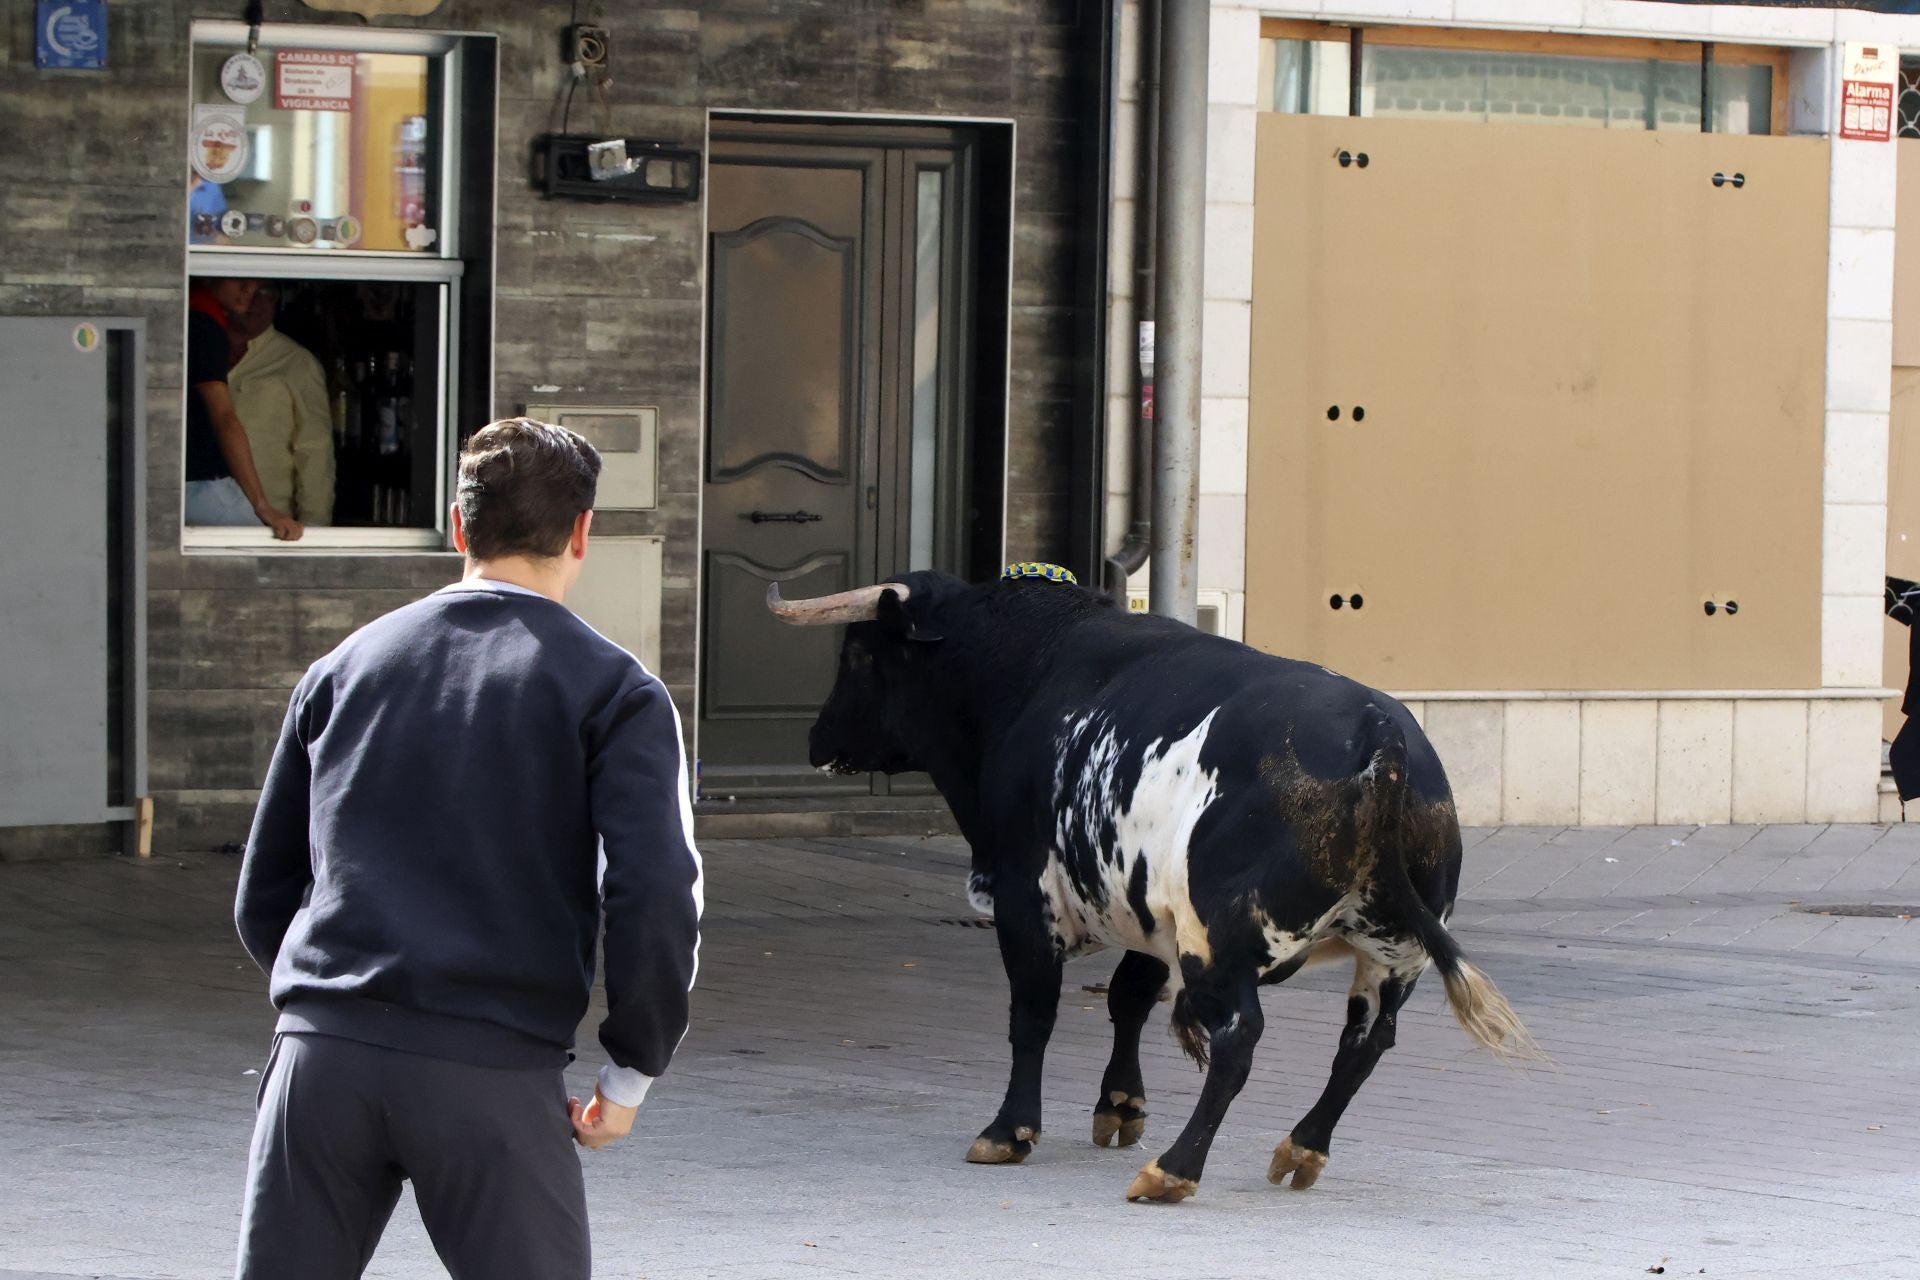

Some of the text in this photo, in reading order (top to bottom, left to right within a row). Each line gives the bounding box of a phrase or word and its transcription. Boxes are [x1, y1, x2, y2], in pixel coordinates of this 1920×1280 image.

[277, 52, 355, 65] CAMARAS DE
[1846, 82, 1890, 98] Alarma
[281, 98, 350, 111] VIGILANCIA
